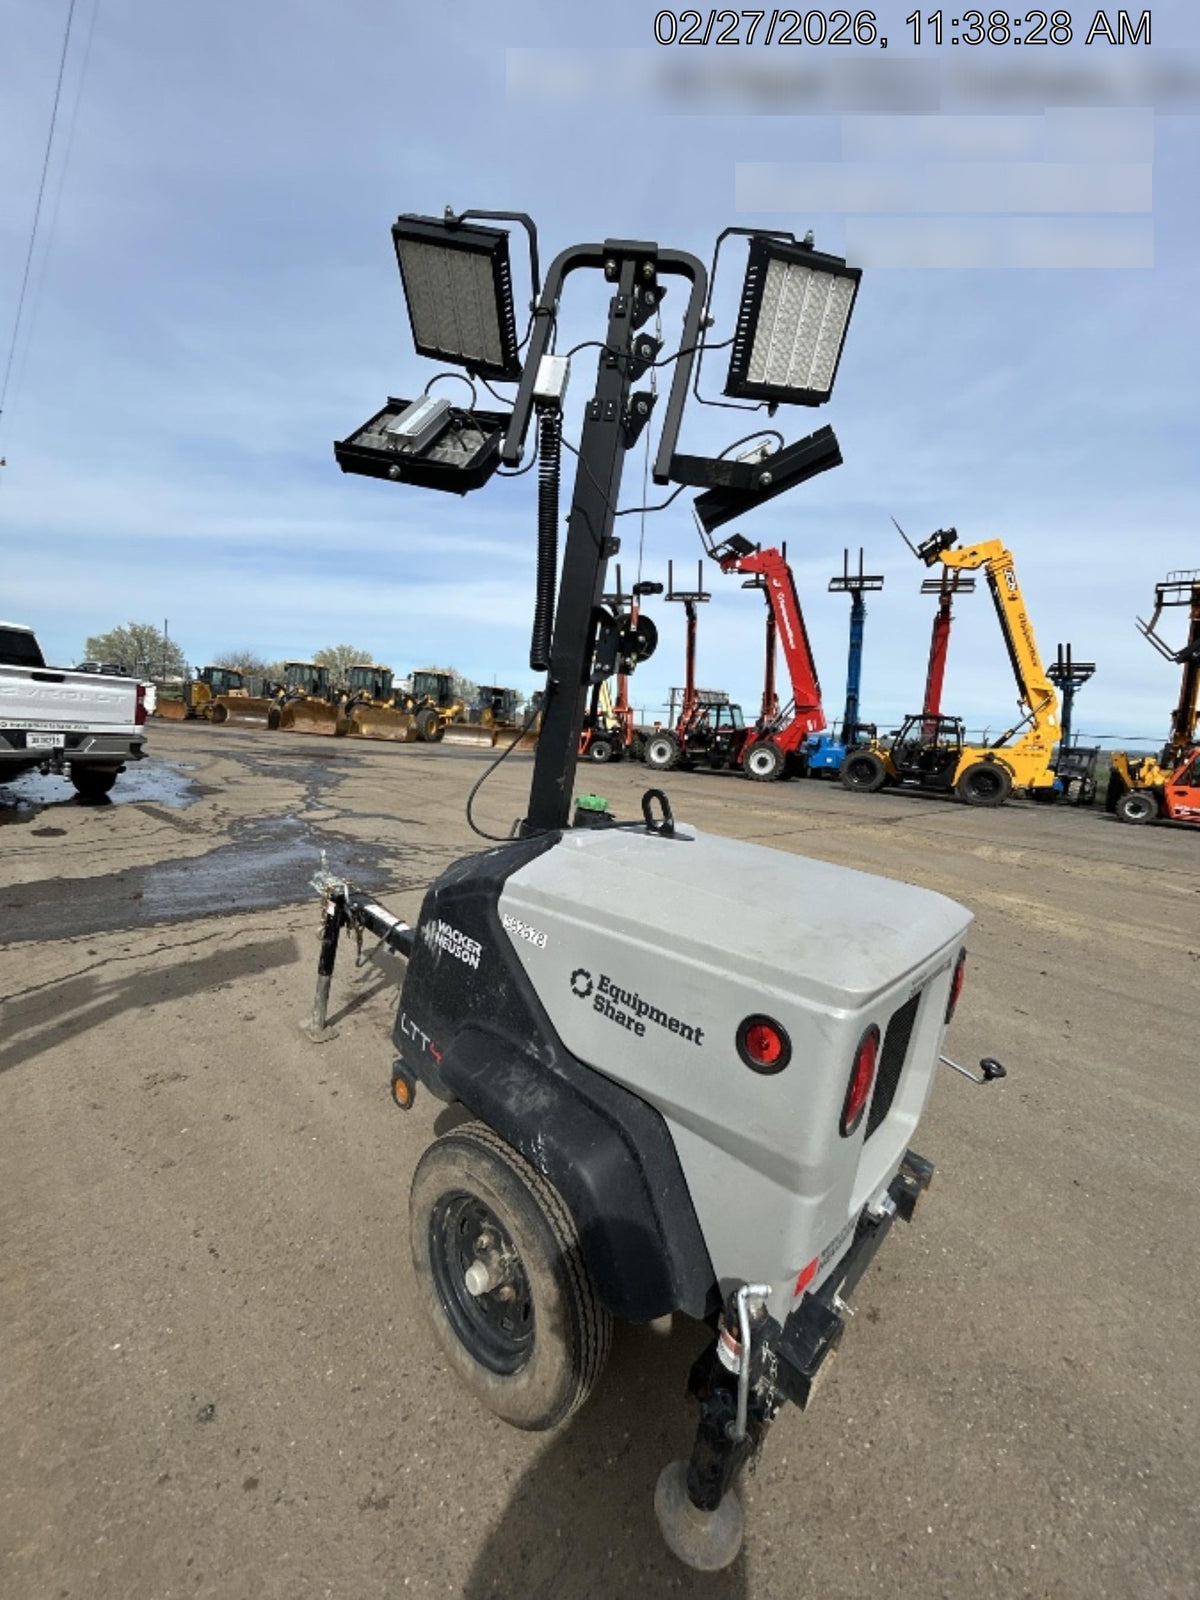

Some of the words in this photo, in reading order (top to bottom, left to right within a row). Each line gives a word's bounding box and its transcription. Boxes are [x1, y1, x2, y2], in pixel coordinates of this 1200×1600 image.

[435, 931, 481, 970] NEUSON
[438, 918, 482, 957] WACKER
[593, 993, 647, 1038] Share
[597, 973, 705, 1046] Equipment
